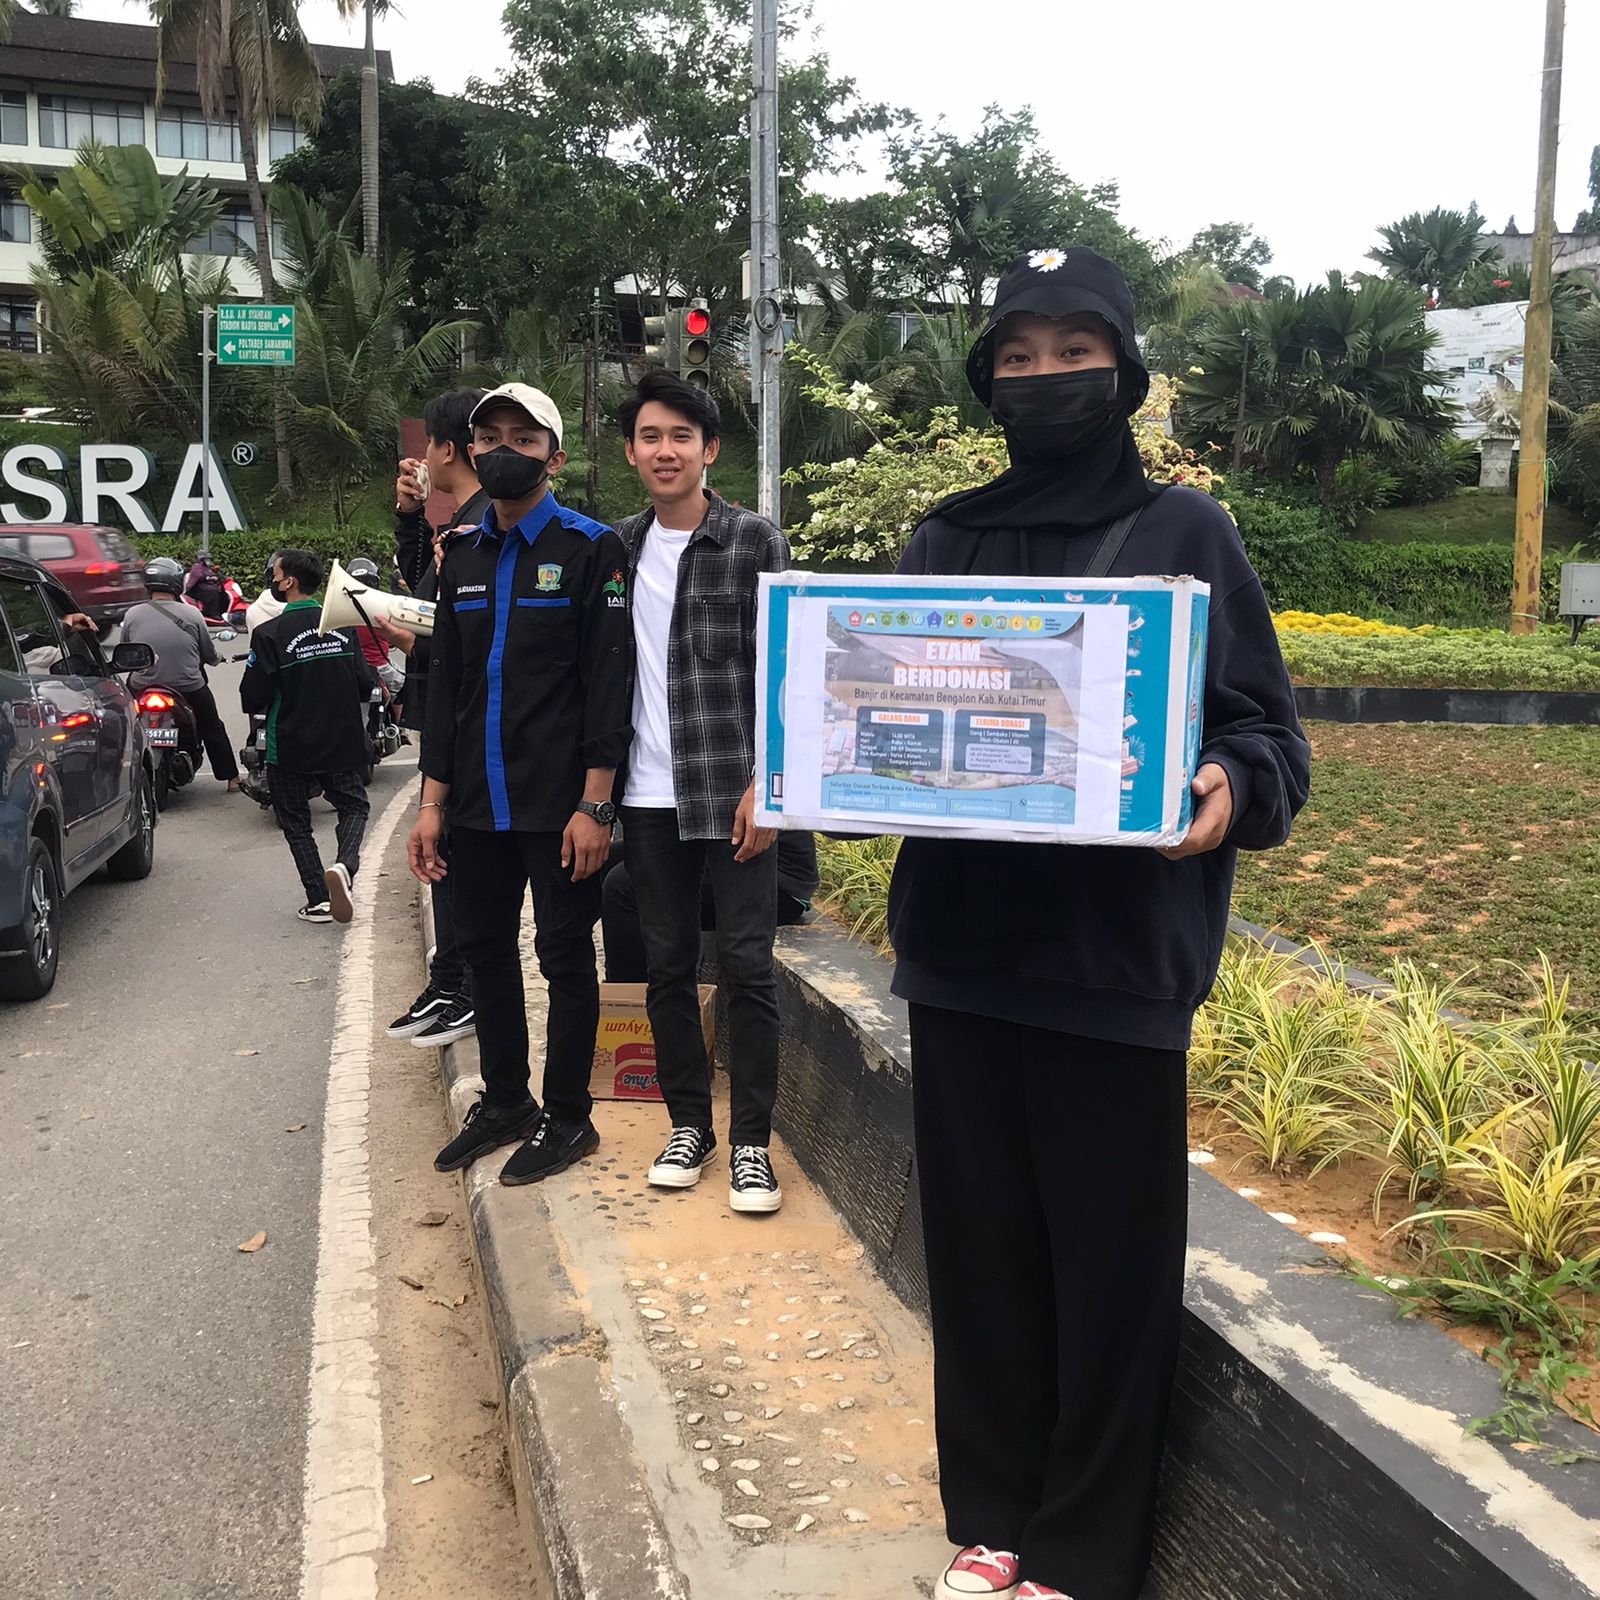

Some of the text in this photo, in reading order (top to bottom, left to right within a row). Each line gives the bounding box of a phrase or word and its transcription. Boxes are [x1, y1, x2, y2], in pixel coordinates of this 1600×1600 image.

[240, 321, 257, 330] MADYA
[258, 322, 279, 331] SEMPAJA
[264, 340, 292, 349] SAMARINDA
[238, 350, 285, 360] KANTOR GUBERNUR
[0, 443, 244, 533] SRA
[926, 638, 981, 662] ETAM
[893, 664, 1011, 691] BERDONASI
[854, 688, 1046, 706] Banjir di Kecamatan Bengalon Kab. Kutai Timur
[976, 717, 1025, 728] TERIMA DONASI
[605, 1020, 641, 1035] Ayam
